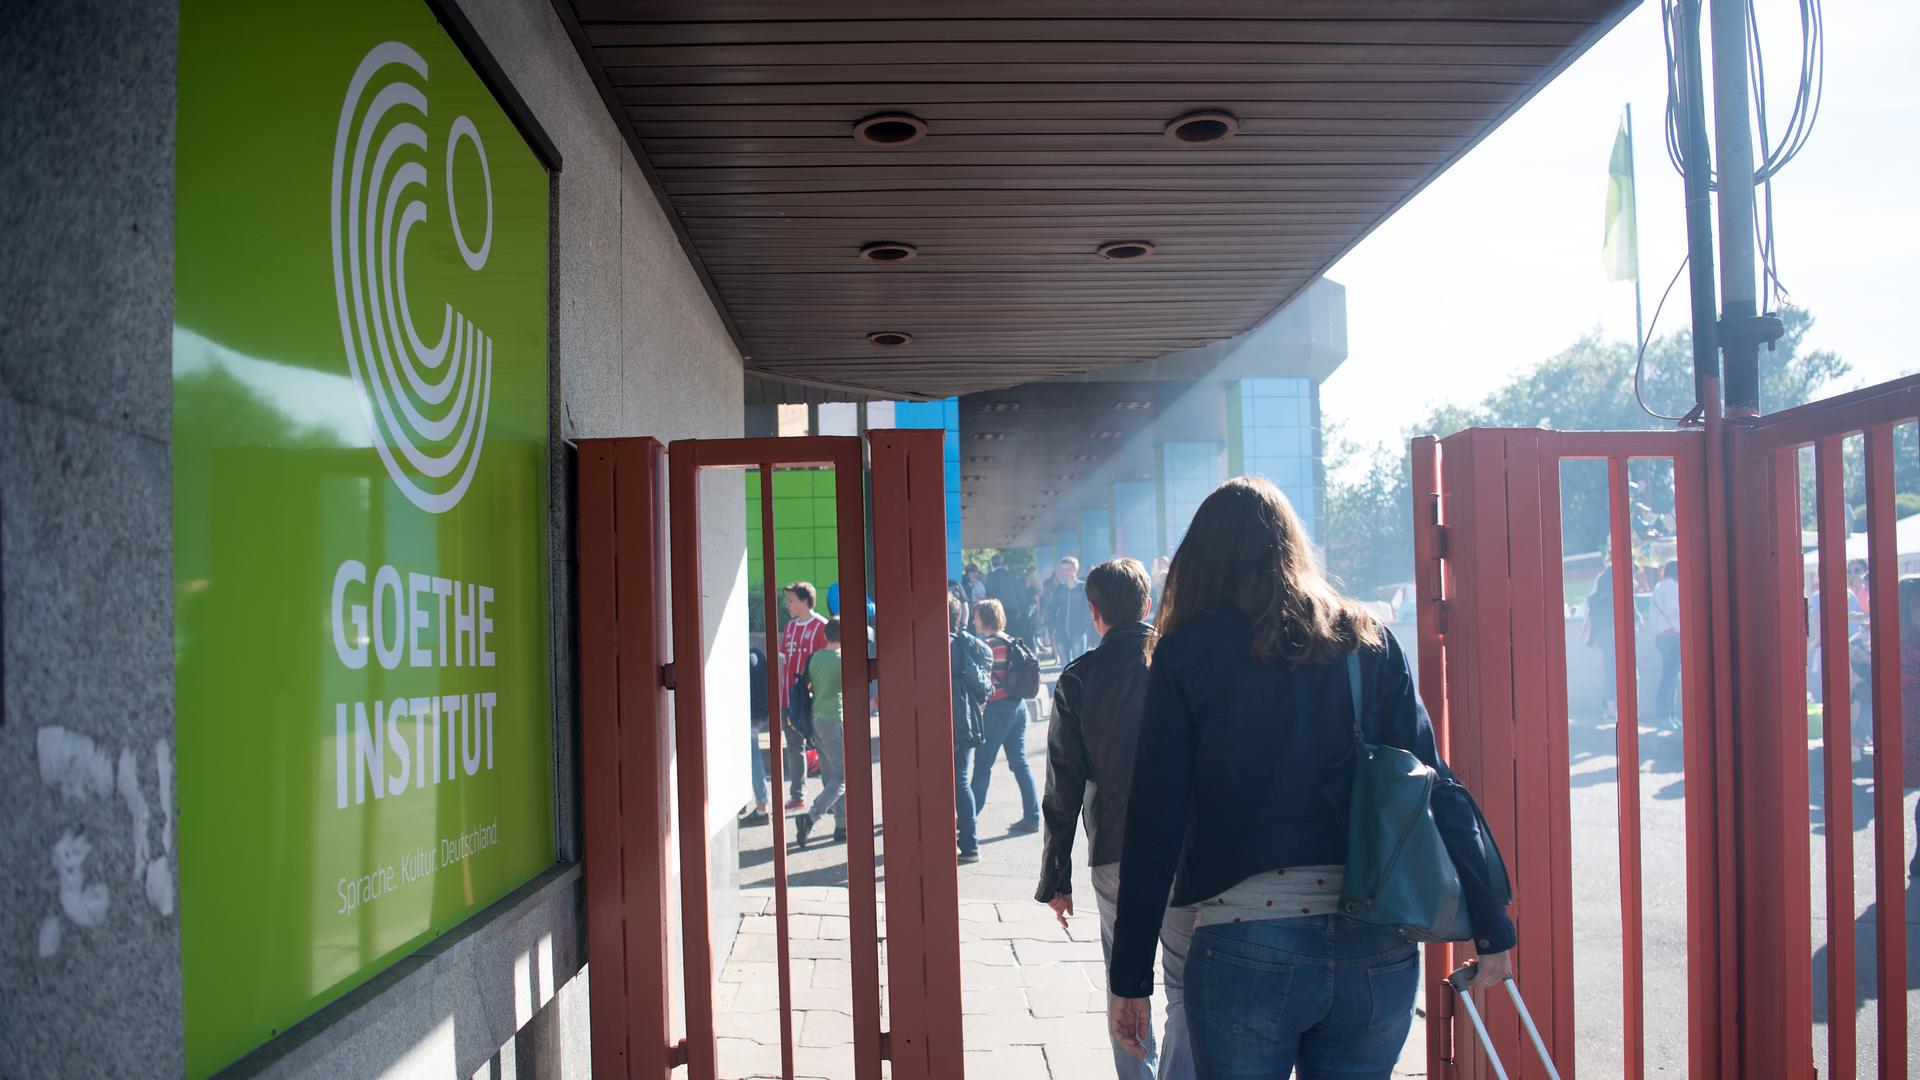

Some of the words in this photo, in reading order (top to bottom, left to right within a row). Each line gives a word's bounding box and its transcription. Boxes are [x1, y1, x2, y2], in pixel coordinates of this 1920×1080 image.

[331, 559, 496, 670] GOETHE
[336, 692, 497, 809] INSTITUT
[337, 863, 397, 916] Sprache.
[401, 847, 438, 886] Kultur.
[441, 818, 499, 867] Deutschland.
